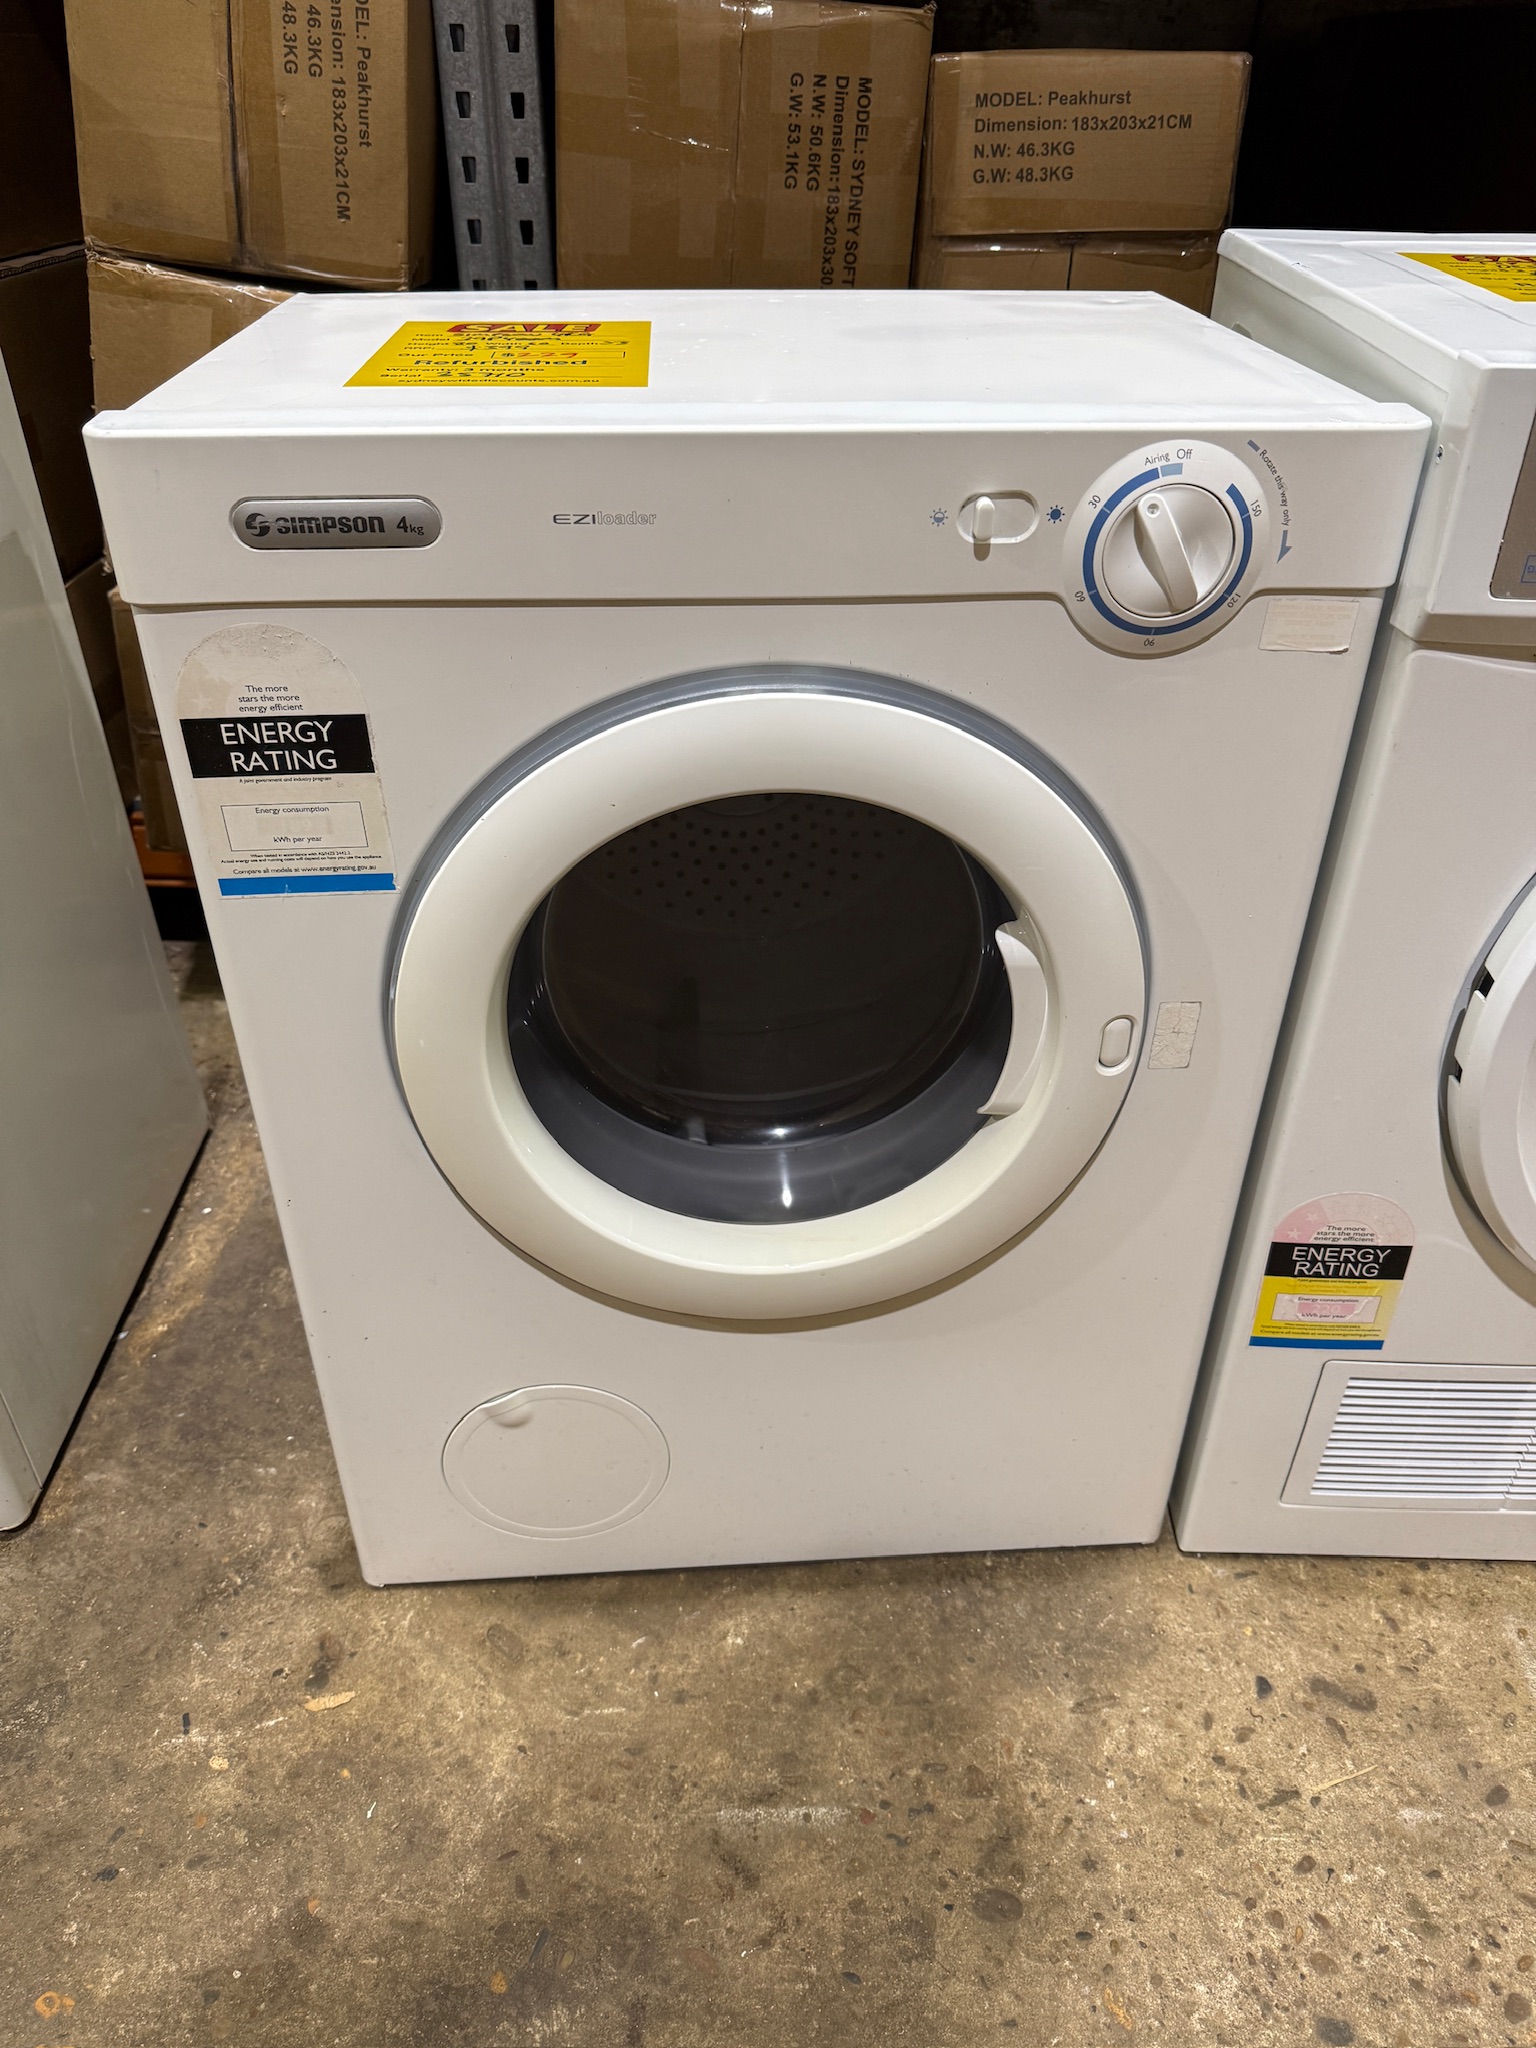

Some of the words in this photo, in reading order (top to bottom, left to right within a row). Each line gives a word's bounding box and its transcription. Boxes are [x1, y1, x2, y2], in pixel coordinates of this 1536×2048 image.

[282, 0, 298, 75] 48.3KG
[306, 4, 323, 78] 46.3KG
[357, 46, 372, 148] Peakhurst
[788, 72, 804, 118] G.W:
[811, 74, 827, 118] N.W:
[975, 91, 1043, 108] MODEL:
[1048, 90, 1132, 106] Peakhurst
[854, 77, 873, 154] MODEL:
[974, 116, 1067, 133] Dimension:
[1072, 114, 1192, 132] 183x203x21CM
[332, 76, 351, 221] 183x203x21CM
[784, 122, 801, 190] 53.1KG
[973, 142, 1011, 159] N.W:
[1016, 141, 1075, 157] 46.3KG
[806, 126, 824, 191] 50.6KG
[973, 168, 1011, 184] G.W:
[1015, 165, 1073, 182] 48.3KG
[847, 158, 865, 237] SYDNEY
[842, 241, 859, 287] SOFT
[460, 323, 592, 333] SALE
[1144, 452, 1171, 466] Airing
[1176, 449, 1193, 460] Off
[1259, 449, 1278, 475] Rotate
[1274, 475, 1285, 490] this
[1088, 495, 1102, 509] 30
[1280, 490, 1289, 507] way
[1250, 499, 1262, 517] 150
[1281, 509, 1292, 526] only
[1074, 590, 1086, 602] 60
[1226, 593, 1242, 608] 120
[245, 685, 263, 693] The
[265, 685, 289, 693] more
[238, 695, 259, 703] stars
[260, 694, 274, 703] the
[276, 694, 300, 702] more
[238, 704, 268, 713] energy
[270, 703, 304, 712] efficient
[219, 720, 334, 745] ENERGY
[229, 748, 338, 772] RATING
[255, 807, 281, 815] Energy
[282, 805, 330, 814] consumption
[293, 836, 305, 844] per
[306, 835, 323, 844] year
[1291, 1246, 1392, 1263] ENERGY
[1294, 1262, 1381, 1277] RATING
